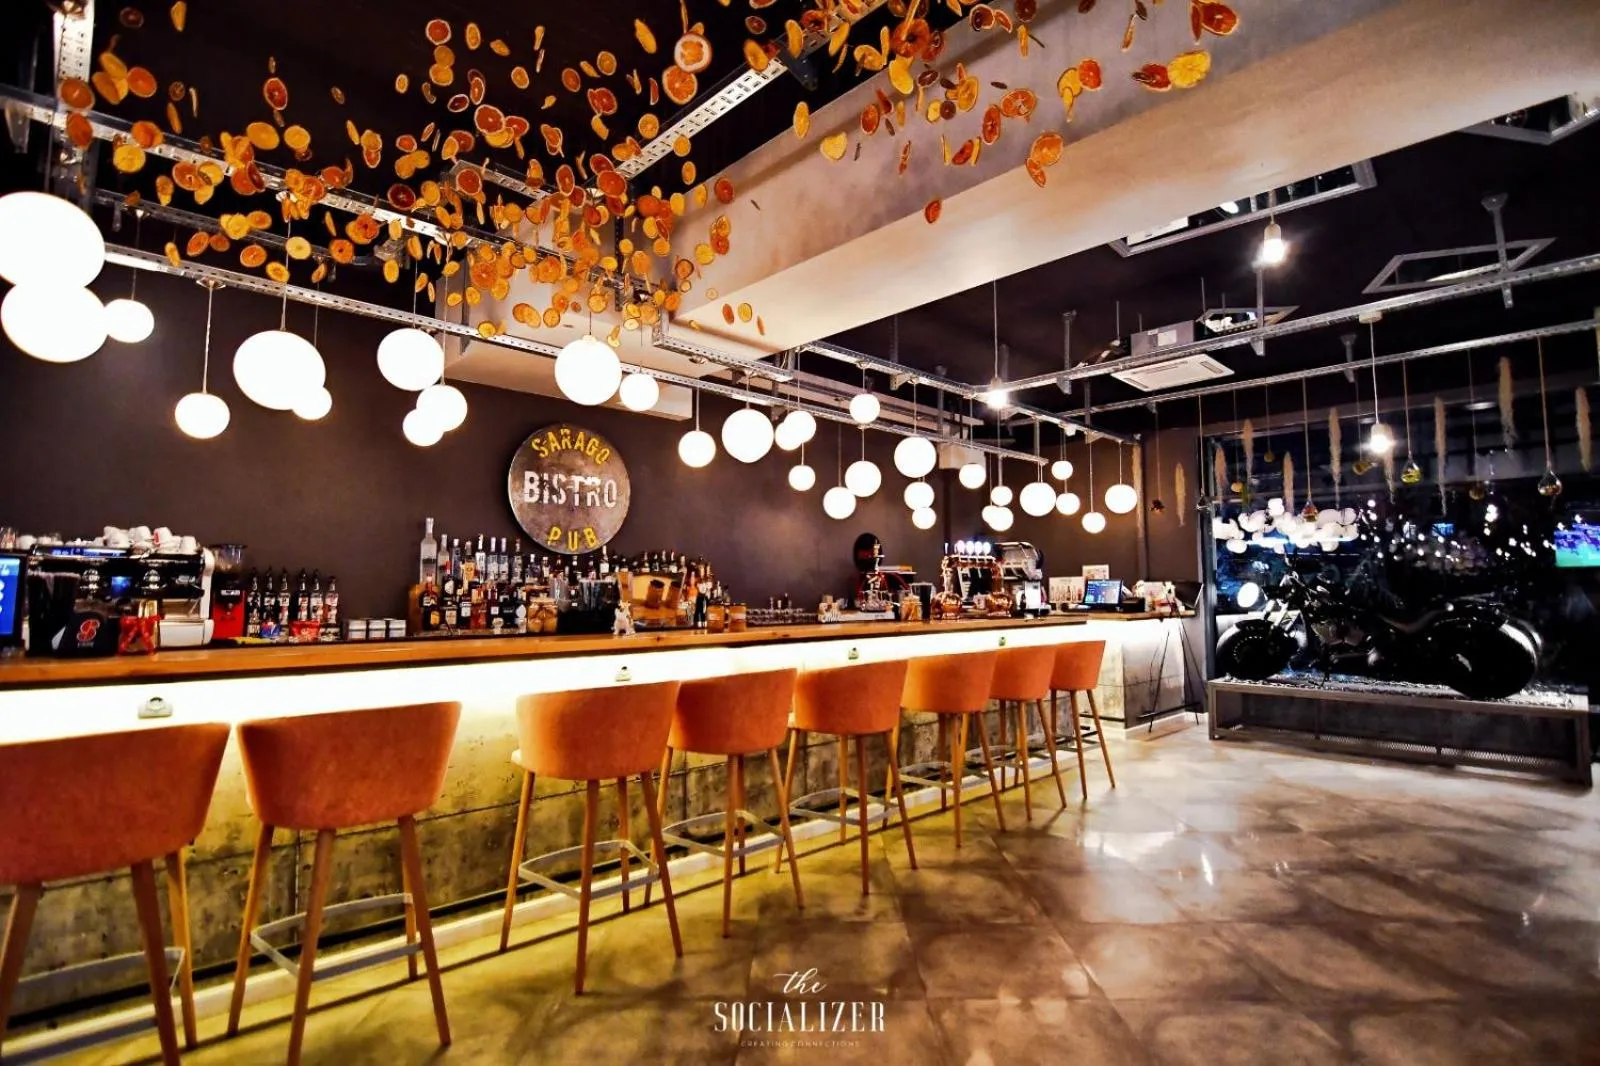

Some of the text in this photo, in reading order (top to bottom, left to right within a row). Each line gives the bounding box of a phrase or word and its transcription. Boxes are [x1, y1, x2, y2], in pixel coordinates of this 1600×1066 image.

[531, 428, 610, 465] SARAGO
[523, 470, 617, 508] BISTRO
[547, 526, 598, 551] PUB
